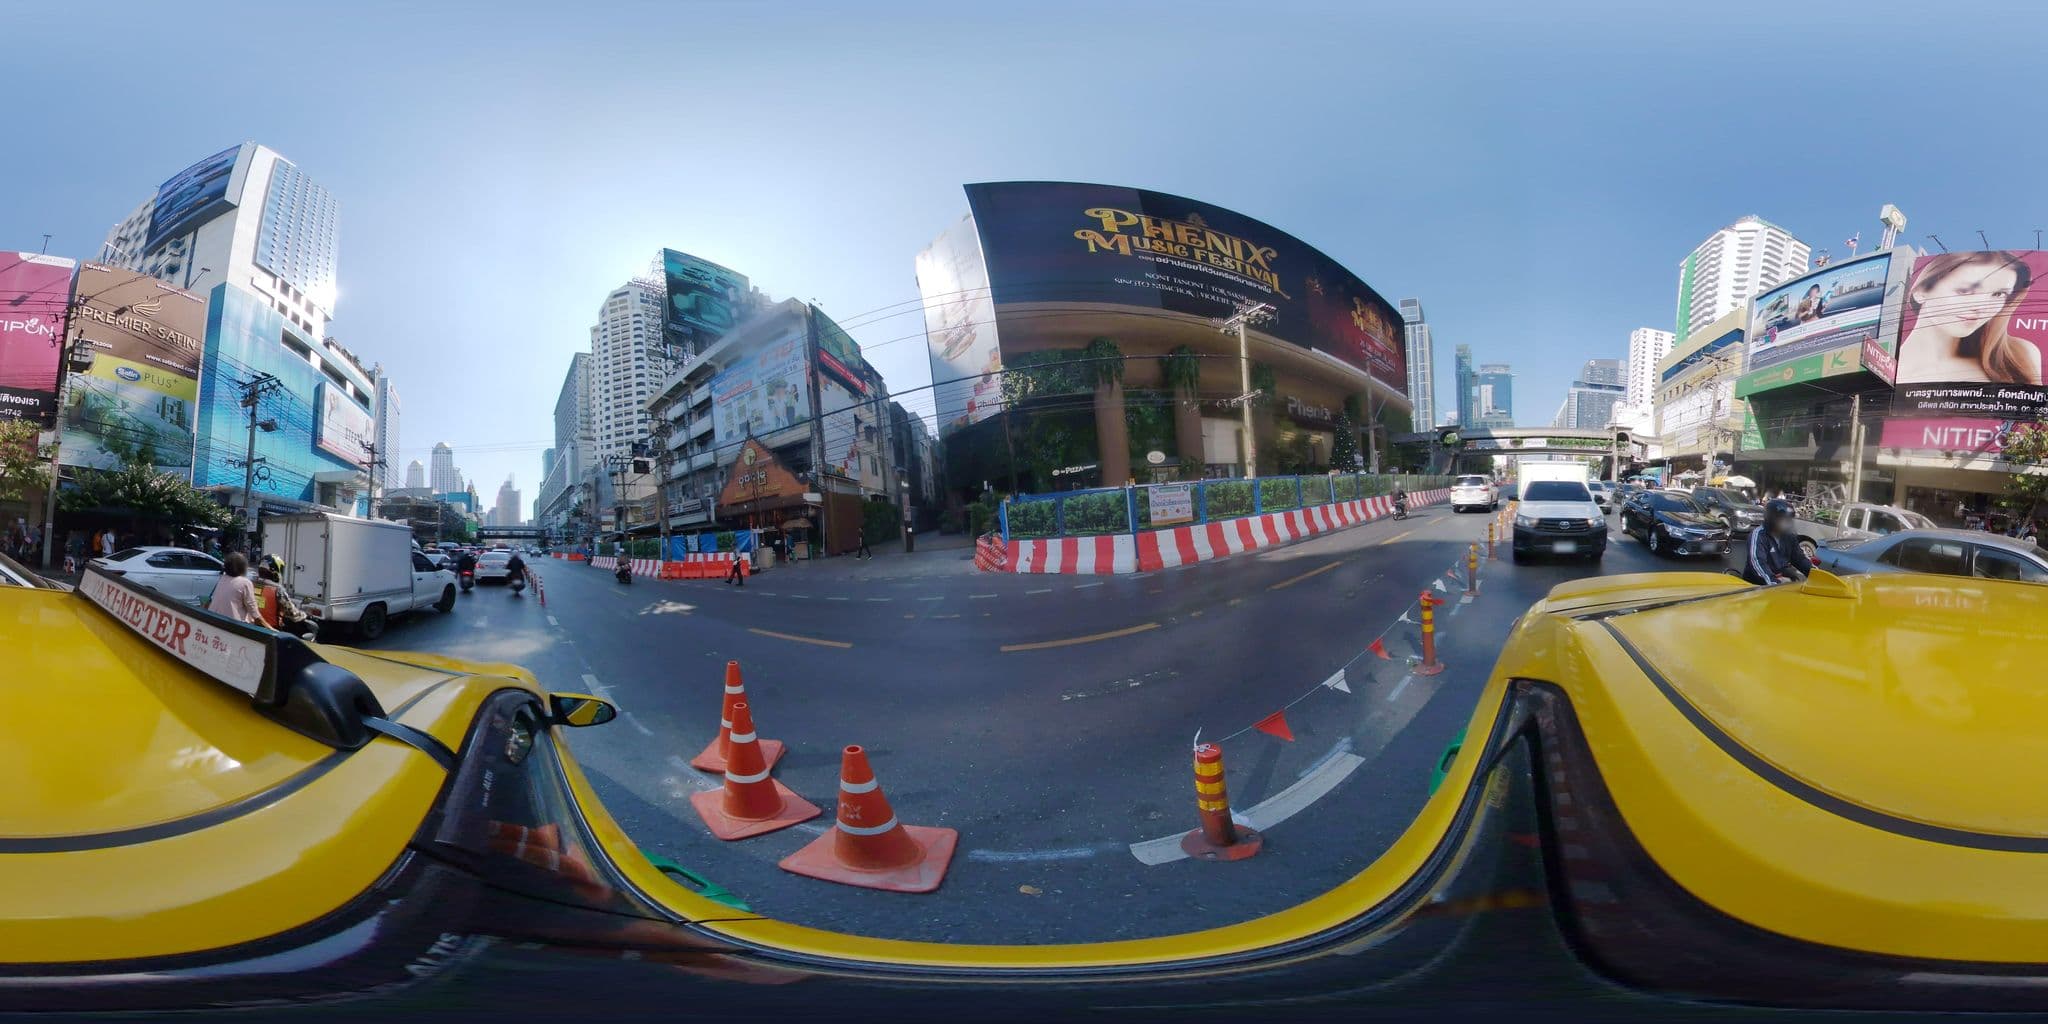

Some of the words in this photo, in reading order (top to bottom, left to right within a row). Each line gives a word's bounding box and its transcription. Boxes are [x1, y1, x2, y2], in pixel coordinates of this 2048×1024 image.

[1073, 229, 1190, 257] MUSIC
[1193, 250, 1293, 300] FESTIVAL
[1083, 207, 1278, 271] PHENIX
[0, 317, 54, 338] IPON
[80, 305, 152, 336] PREMIER
[156, 325, 197, 352] SATIN
